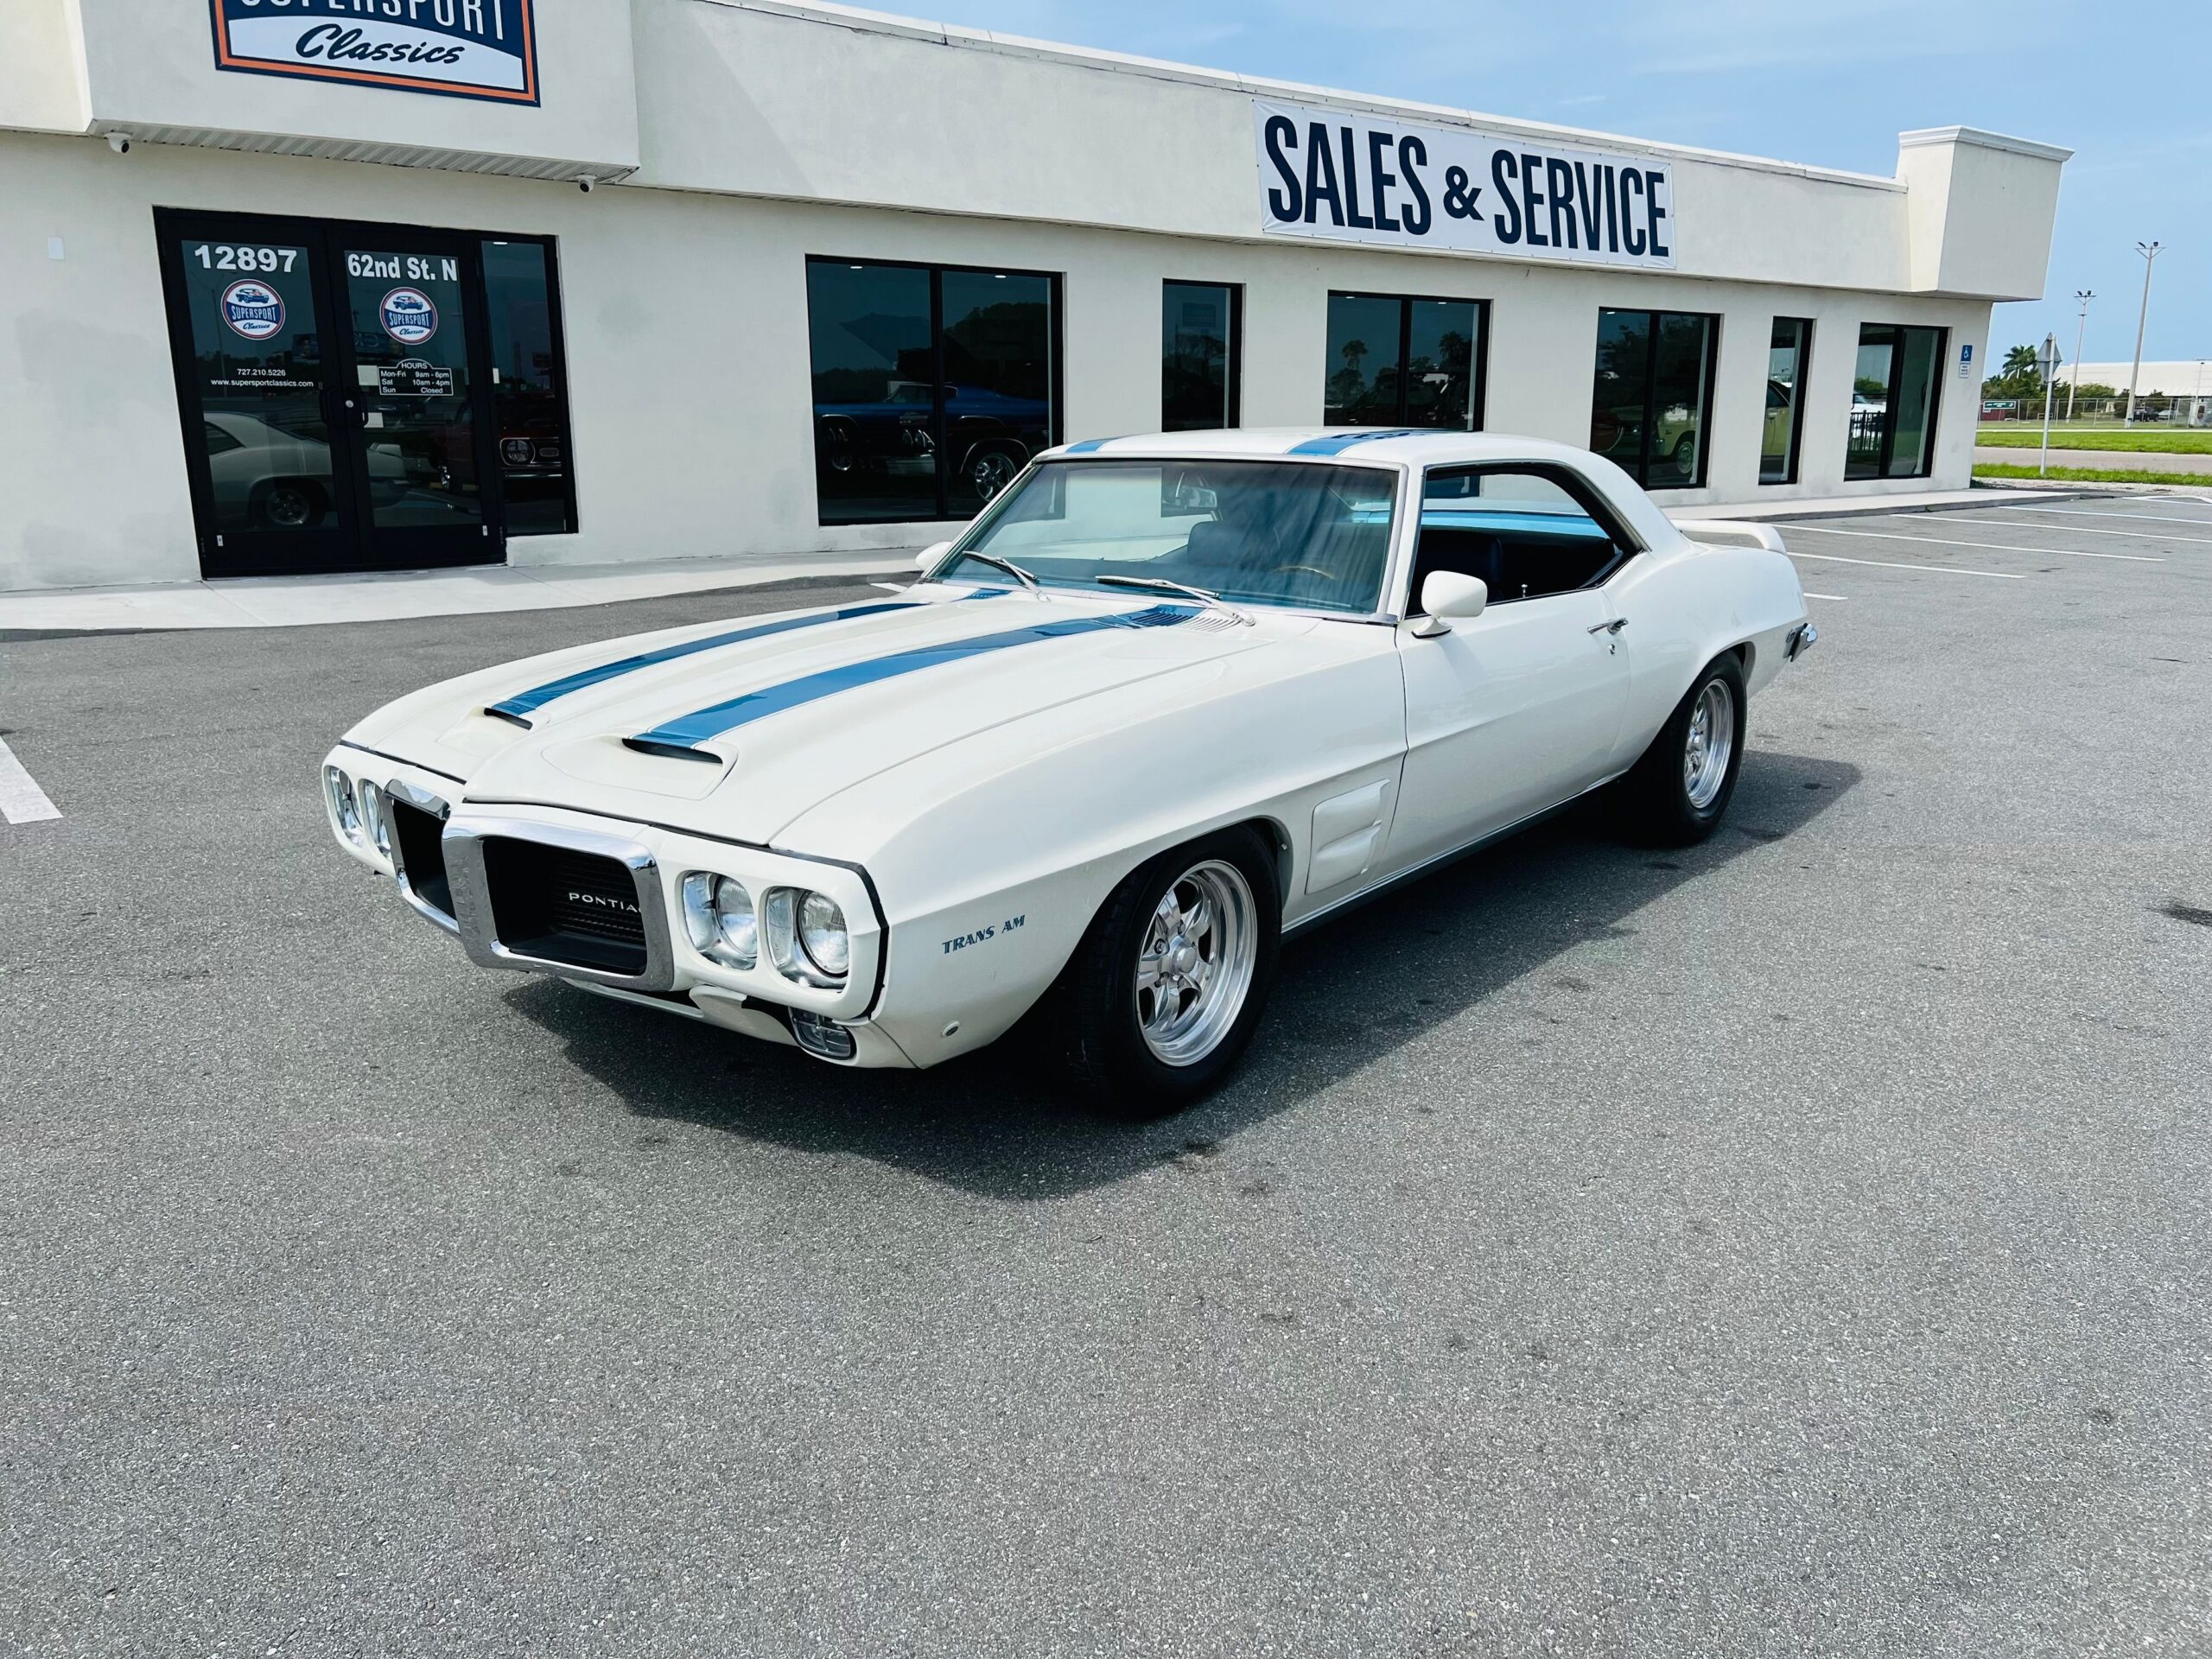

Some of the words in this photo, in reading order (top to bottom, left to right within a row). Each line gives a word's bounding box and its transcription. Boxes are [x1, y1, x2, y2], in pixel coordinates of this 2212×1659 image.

[296, 23, 465, 65] Classics
[1264, 115, 1432, 236] SALES
[1443, 165, 1485, 221] &
[1491, 149, 1669, 257] SERVICE
[194, 245, 297, 273] 12897
[347, 253, 401, 279] 62nd
[407, 257, 436, 281] St.
[442, 258, 458, 282] N
[232, 306, 276, 321] SUPERSPORT
[389, 312, 429, 327] SUPERSPORT
[237, 368, 286, 377] 727.210.5226
[569, 892, 642, 913] PONTIA
[942, 925, 995, 954] TRANS
[1001, 914, 1026, 934] AM
